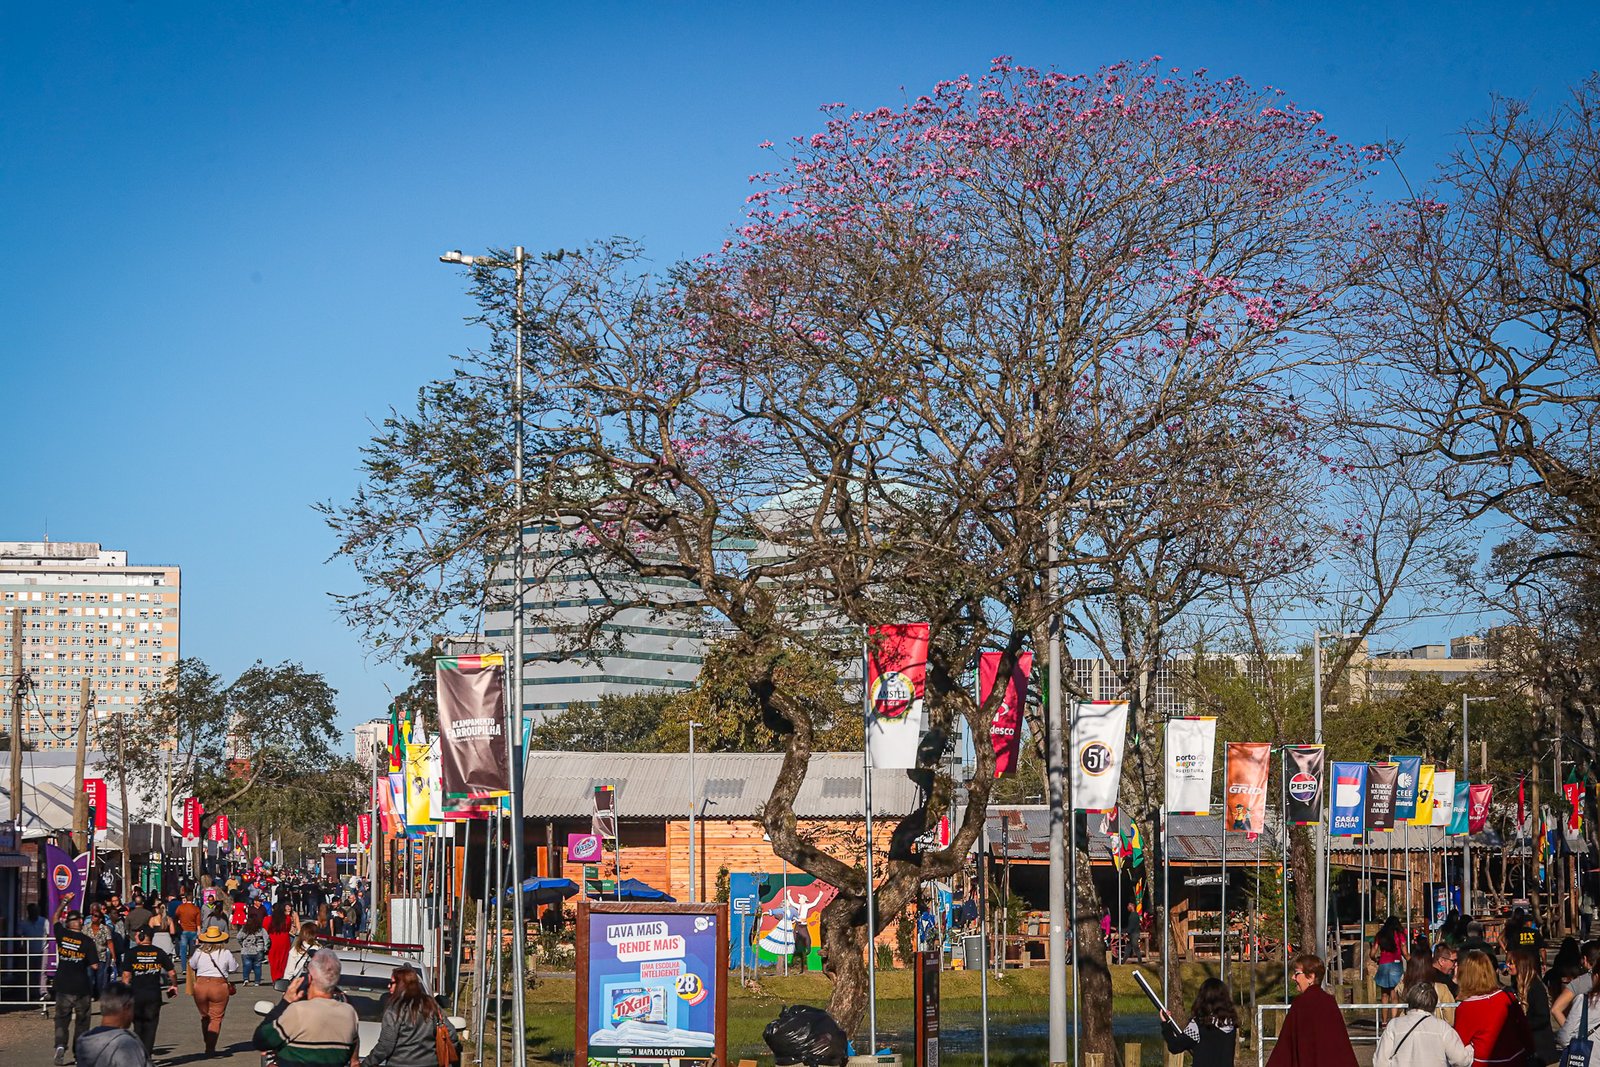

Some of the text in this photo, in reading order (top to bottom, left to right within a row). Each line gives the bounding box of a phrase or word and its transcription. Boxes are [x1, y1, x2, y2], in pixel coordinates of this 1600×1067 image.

[452, 717, 495, 729] ACAMPAMENTO
[446, 723, 501, 739] FARROUPILHA
[989, 725, 1015, 736] desco
[1087, 747, 1105, 769] 51
[1175, 754, 1197, 762] porto
[1290, 783, 1317, 791] PEPSI
[187, 799, 195, 831] AMSTEL
[1334, 815, 1360, 823] CASAS
[608, 923, 662, 939] LAVA MAIS
[618, 940, 651, 954] RENDE
[655, 961, 680, 970] ESCOLHA
[641, 969, 680, 978] INTELIGENTE
[677, 975, 697, 994] 28
[638, 1048, 654, 1056] MAPA
[654, 1048, 664, 1056] DO
[663, 1048, 686, 1056] EVENTO
